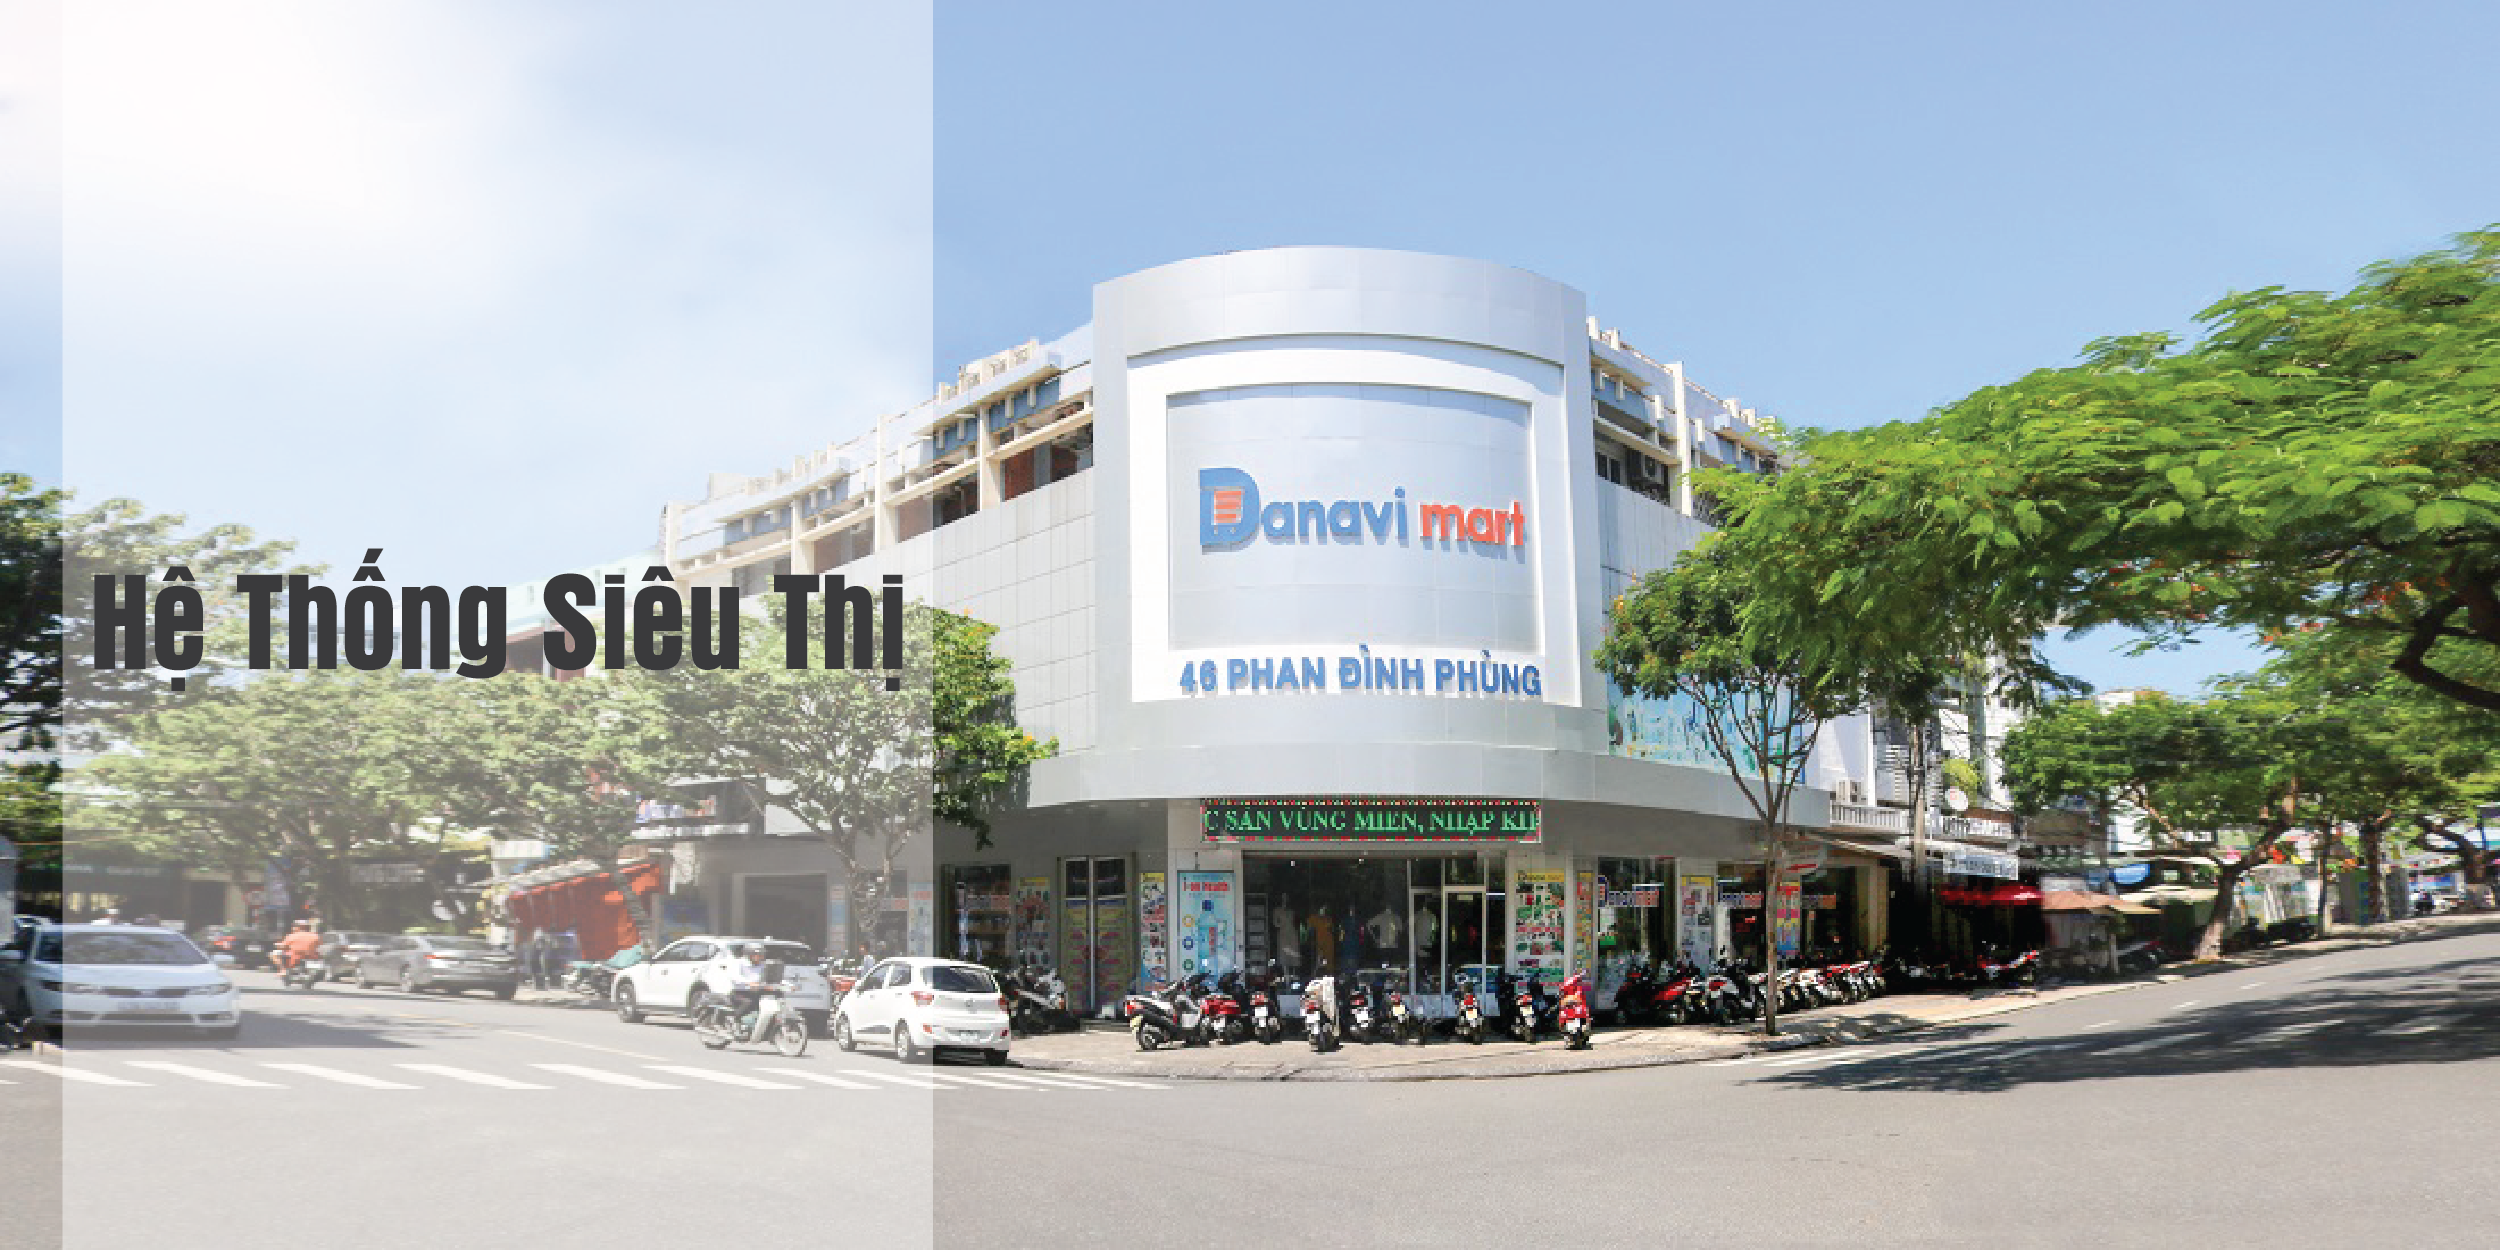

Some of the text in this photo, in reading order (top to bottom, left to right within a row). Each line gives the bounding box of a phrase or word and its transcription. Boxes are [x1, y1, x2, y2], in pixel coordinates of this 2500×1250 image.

[1199, 467, 1526, 546] Danavi mart
[1179, 643, 1542, 696] 46 PHAN ĐÌNH PHÙNG
